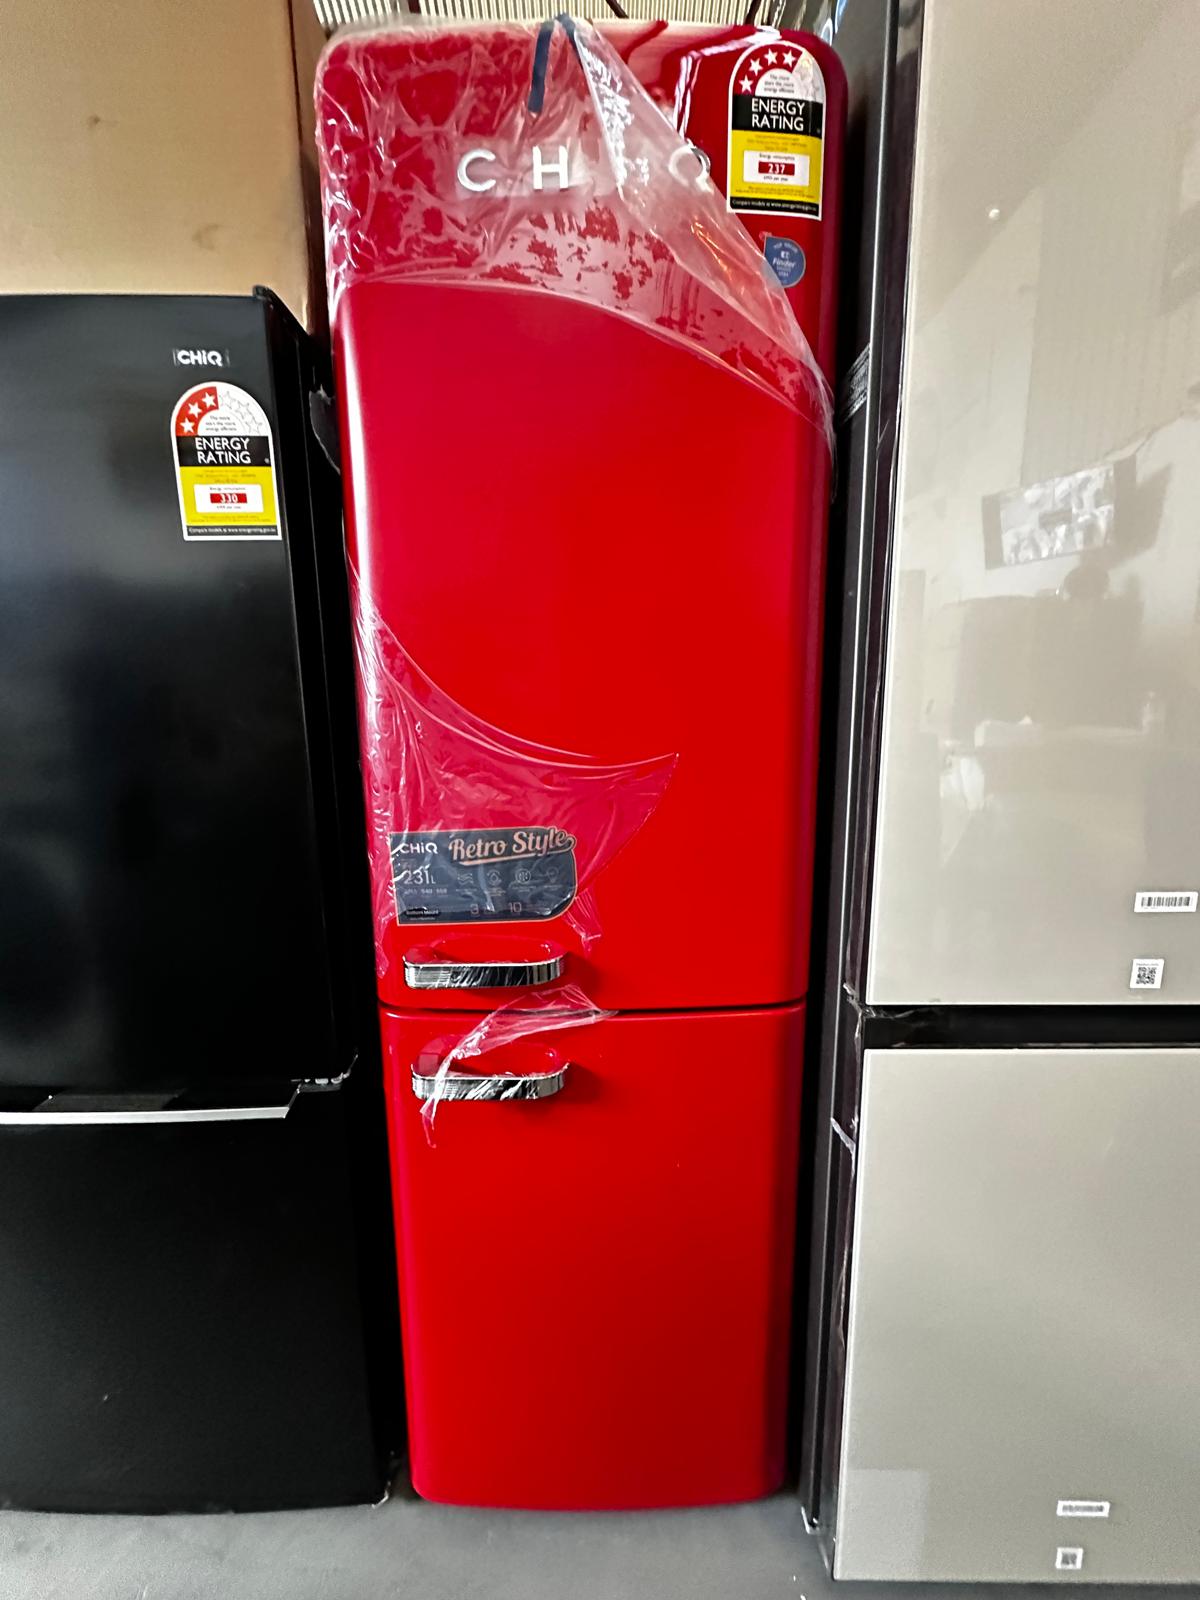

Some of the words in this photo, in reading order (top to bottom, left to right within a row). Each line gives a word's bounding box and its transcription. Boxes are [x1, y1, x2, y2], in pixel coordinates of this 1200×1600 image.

[751, 97, 805, 116] ENERGY
[751, 113, 804, 132] RATING
[768, 163, 786, 174] 237
[195, 437, 251, 451] ENERGY
[196, 450, 252, 465] RATING
[448, 838, 508, 861] Retro
[512, 828, 567, 857] Style
